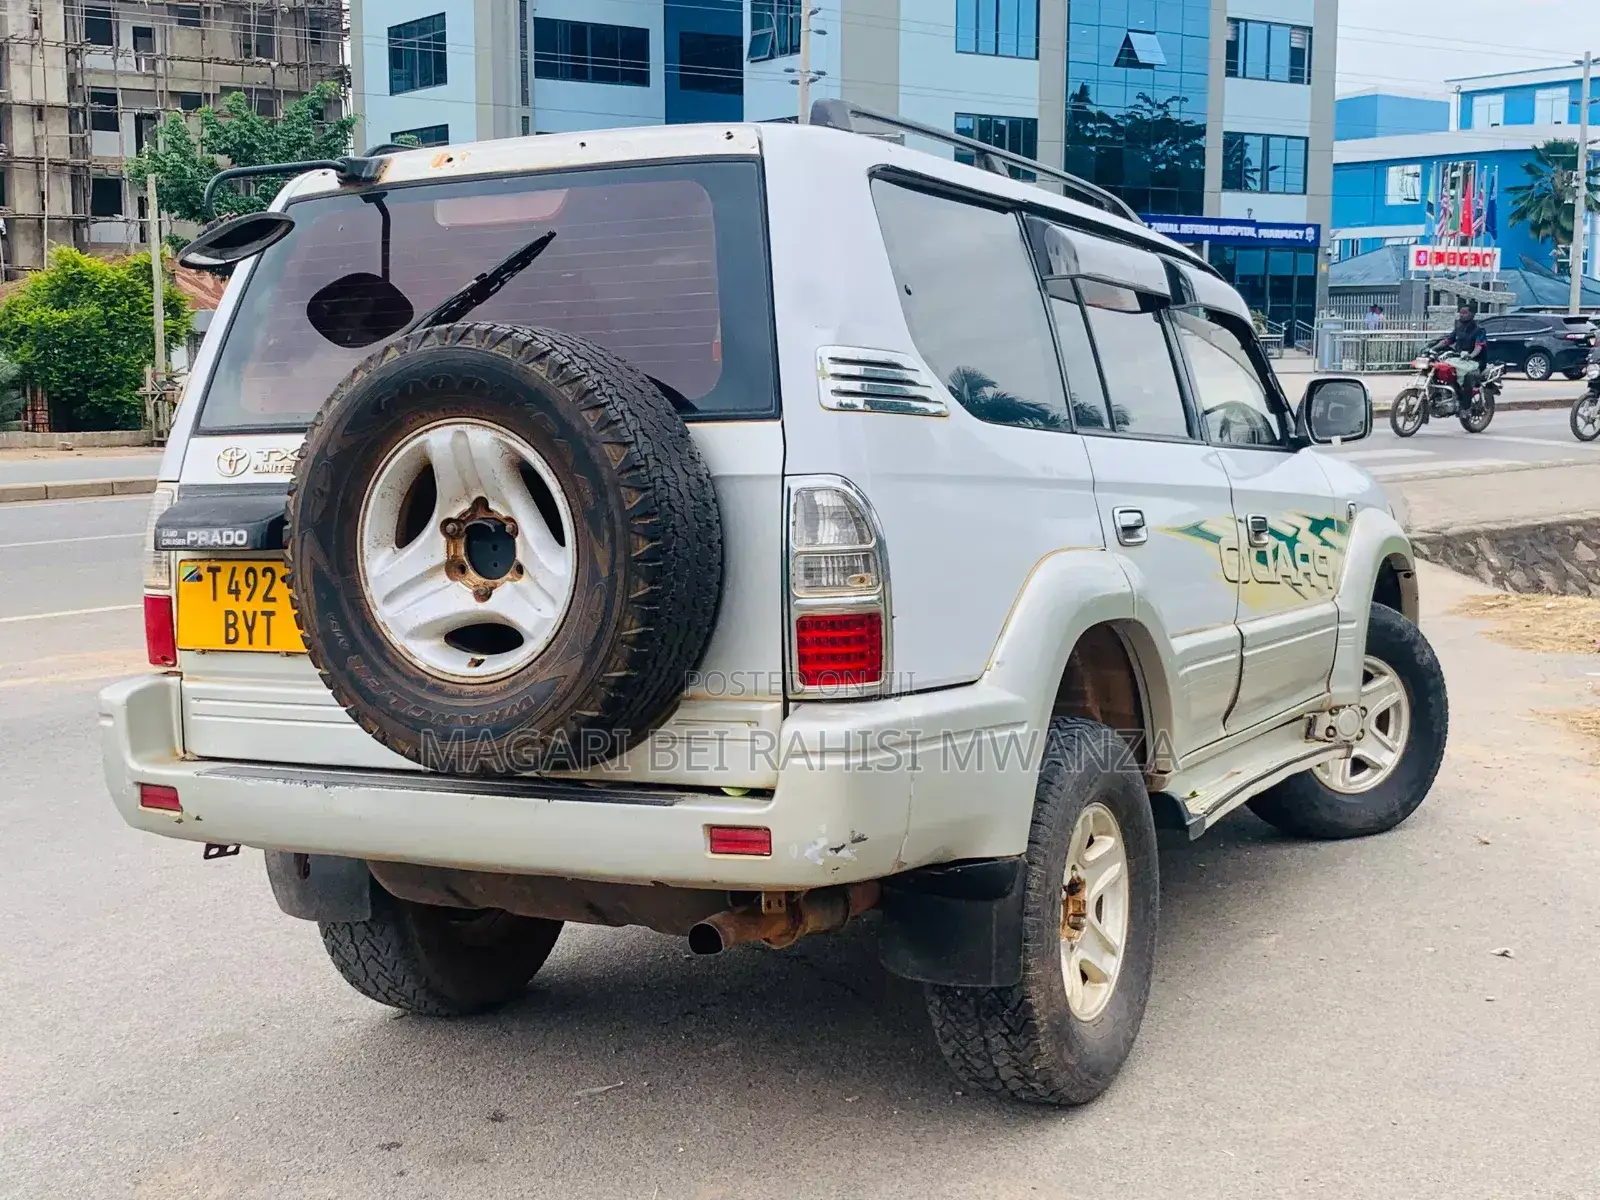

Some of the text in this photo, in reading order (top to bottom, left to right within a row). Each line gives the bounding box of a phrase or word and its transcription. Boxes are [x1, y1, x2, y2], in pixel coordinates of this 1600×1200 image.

[1258, 228, 1304, 240] PHARMACY
[162, 530, 178, 538] LAND
[187, 529, 248, 546] PRADO
[162, 538, 186, 546] CRUISER
[206, 566, 277, 602] T492
[224, 609, 276, 646] BYT
